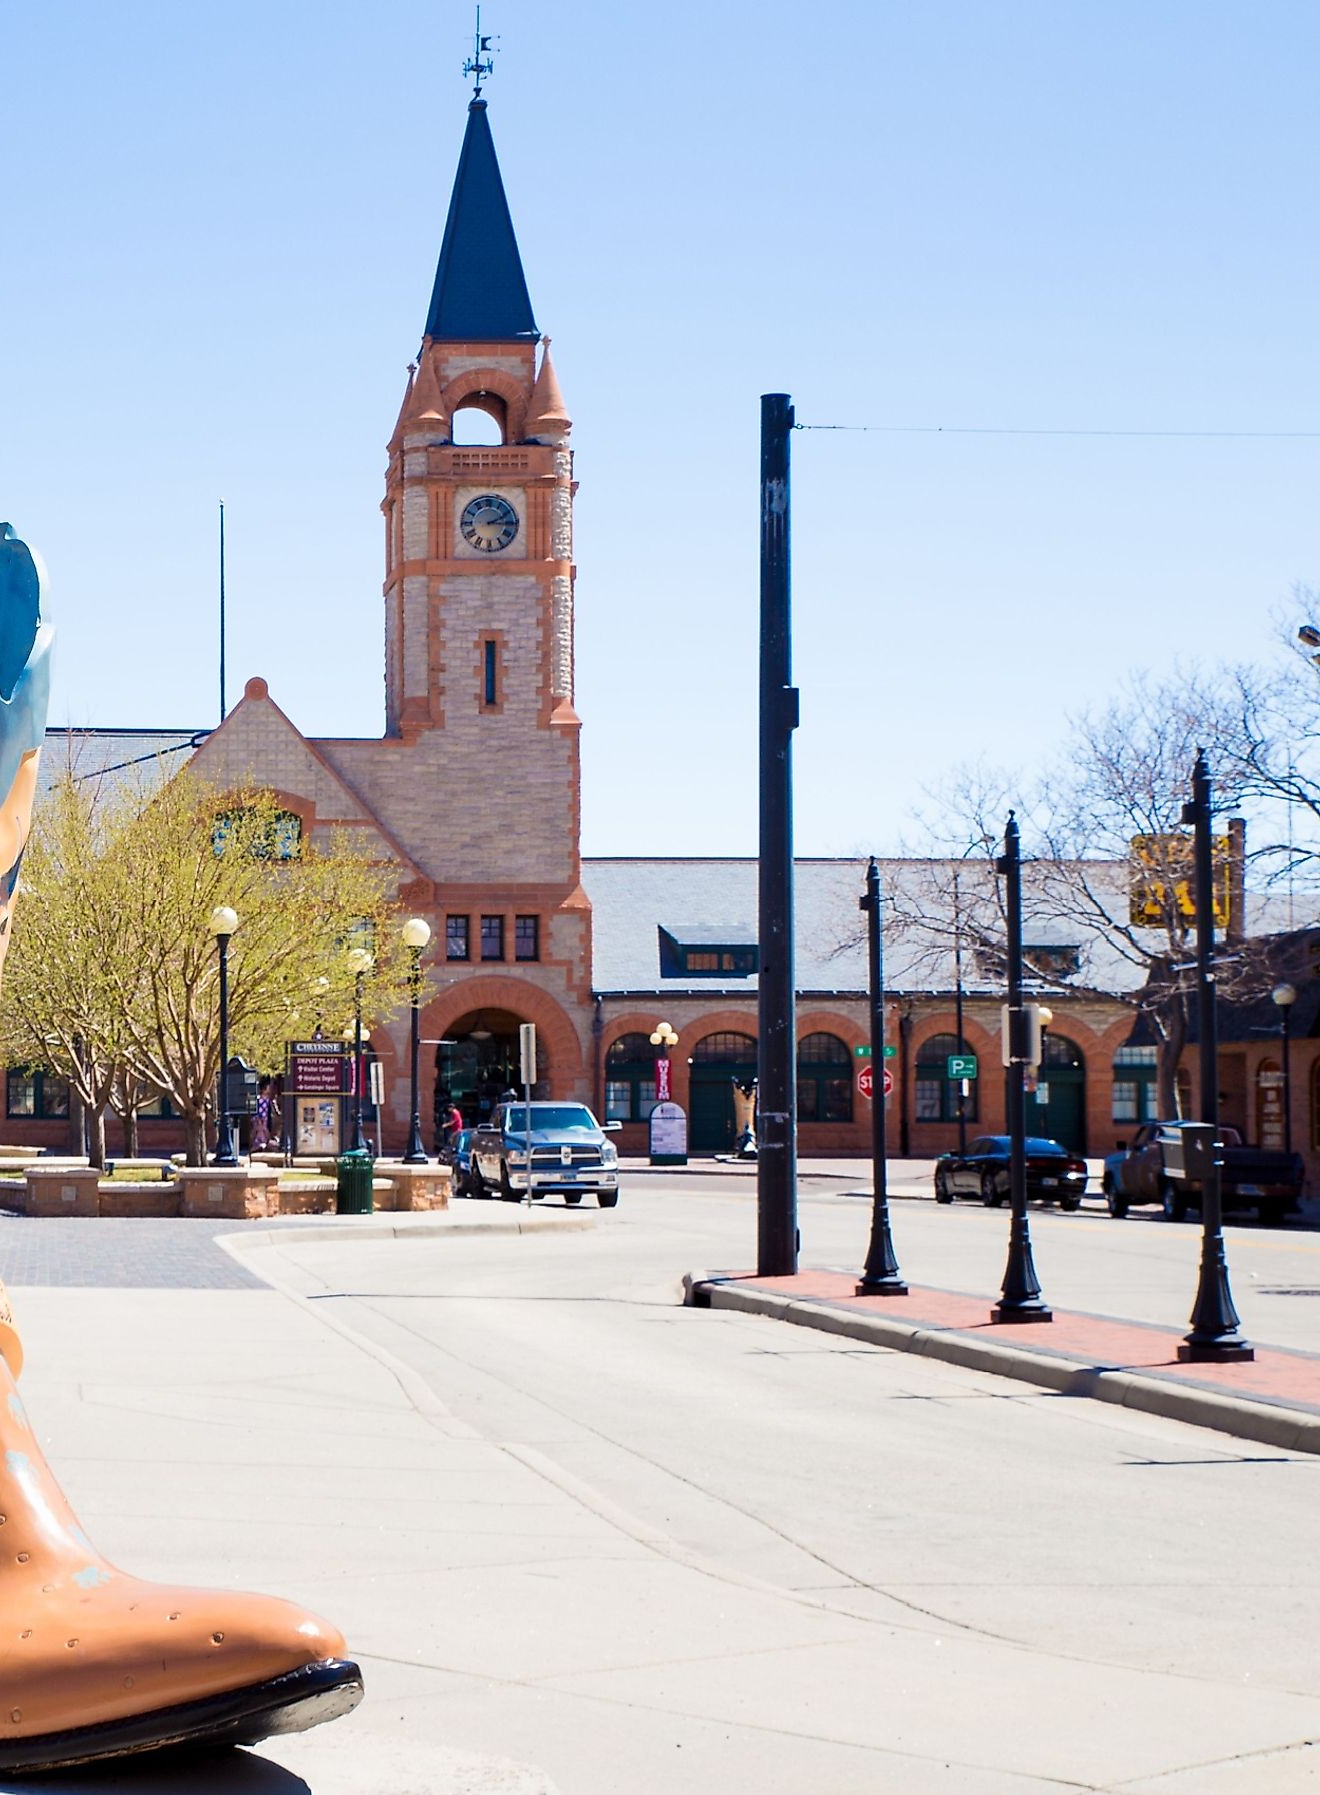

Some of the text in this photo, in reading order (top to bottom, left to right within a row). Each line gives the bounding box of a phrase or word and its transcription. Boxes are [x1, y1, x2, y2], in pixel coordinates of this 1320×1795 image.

[296, 1043, 340, 1052] CHEYENNE
[952, 1060, 965, 1074] P
[658, 1060, 669, 1100] MUSEUM
[860, 1076, 890, 1089] STP
